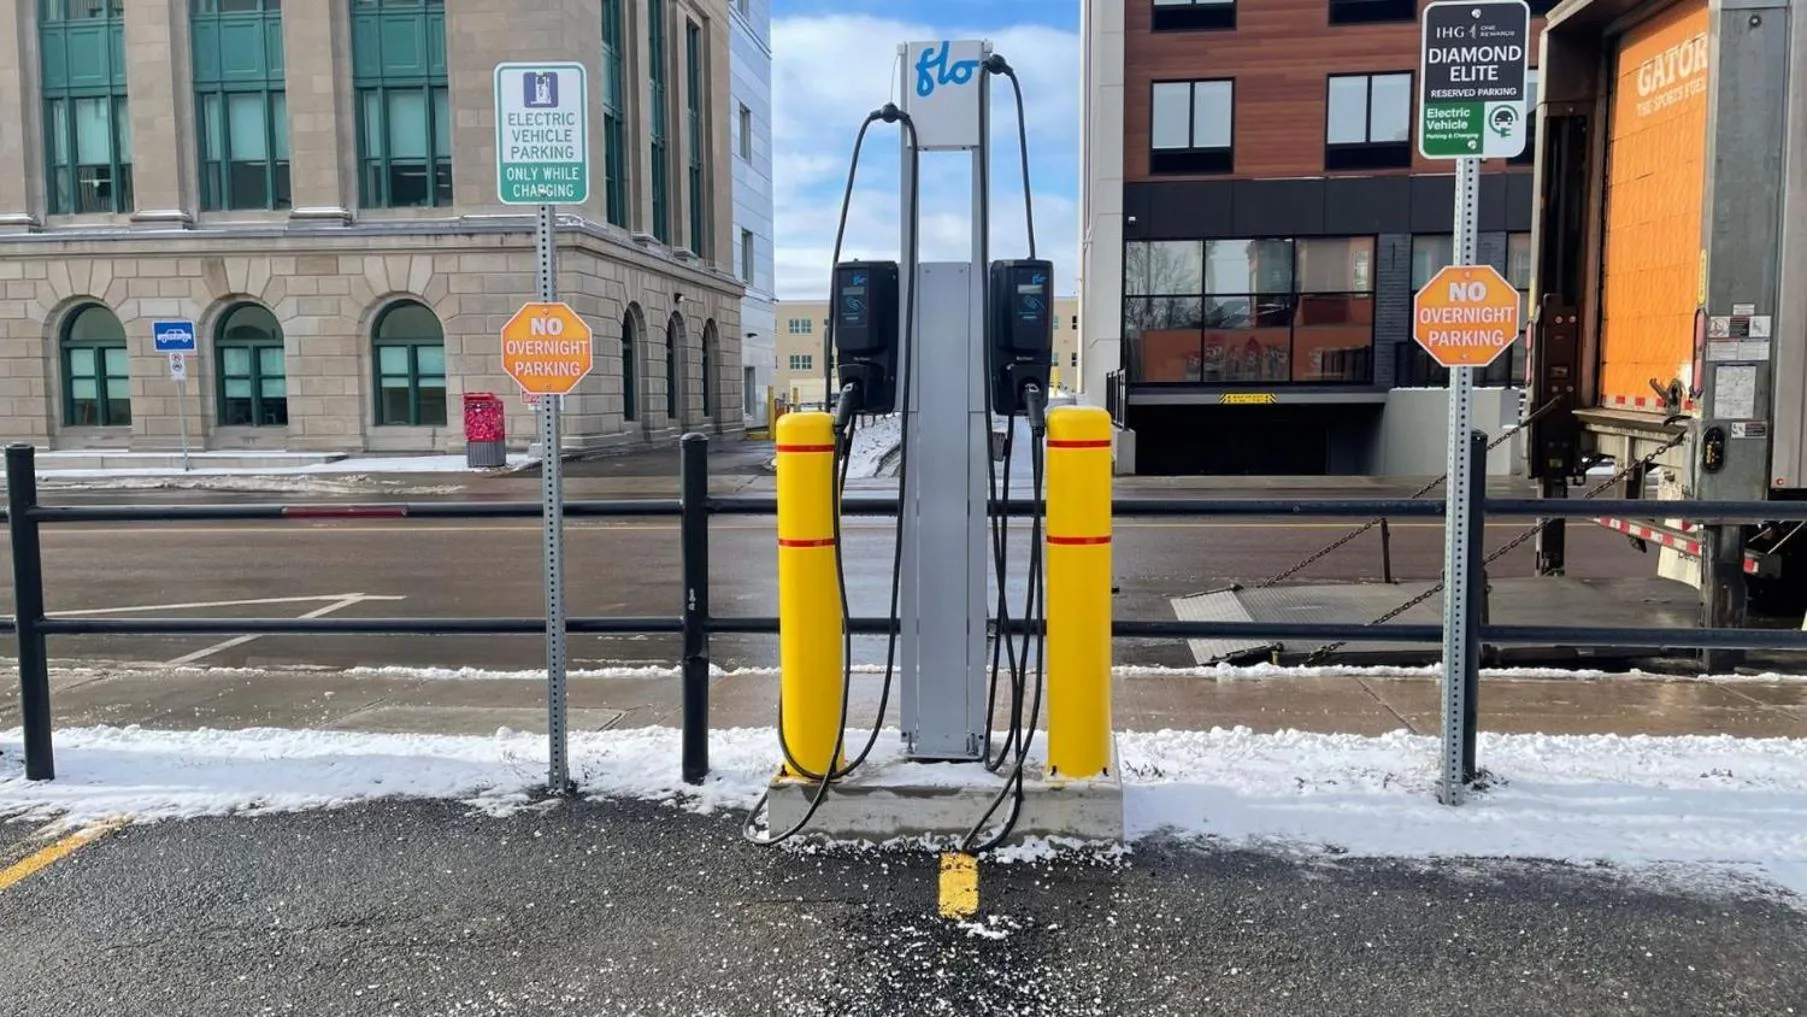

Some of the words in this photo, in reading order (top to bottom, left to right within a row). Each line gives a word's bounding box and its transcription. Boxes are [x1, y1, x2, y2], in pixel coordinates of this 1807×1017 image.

[1436, 26, 1465, 39] IHG
[1428, 45, 1522, 64] DIAMOND
[915, 41, 979, 97] flo
[1450, 65, 1499, 82] ELITE
[1430, 88, 1476, 98] RESERVED
[1477, 87, 1517, 97] PARKING
[507, 112, 576, 126] ELECTRIC
[1426, 107, 1471, 119] Electric
[1426, 119, 1469, 130] Vehicle
[511, 129, 573, 143] VEHICLE
[511, 145, 574, 159] PARKING
[506, 167, 539, 181] ONLY
[542, 166, 580, 181] WHILE
[1449, 281, 1487, 302] NO
[1419, 306, 1515, 324] OVERNIGHT
[530, 317, 564, 336] NO
[1428, 329, 1504, 347] PARKING
[505, 340, 589, 356] OVERNIGHT
[514, 361, 581, 377] PARKING
